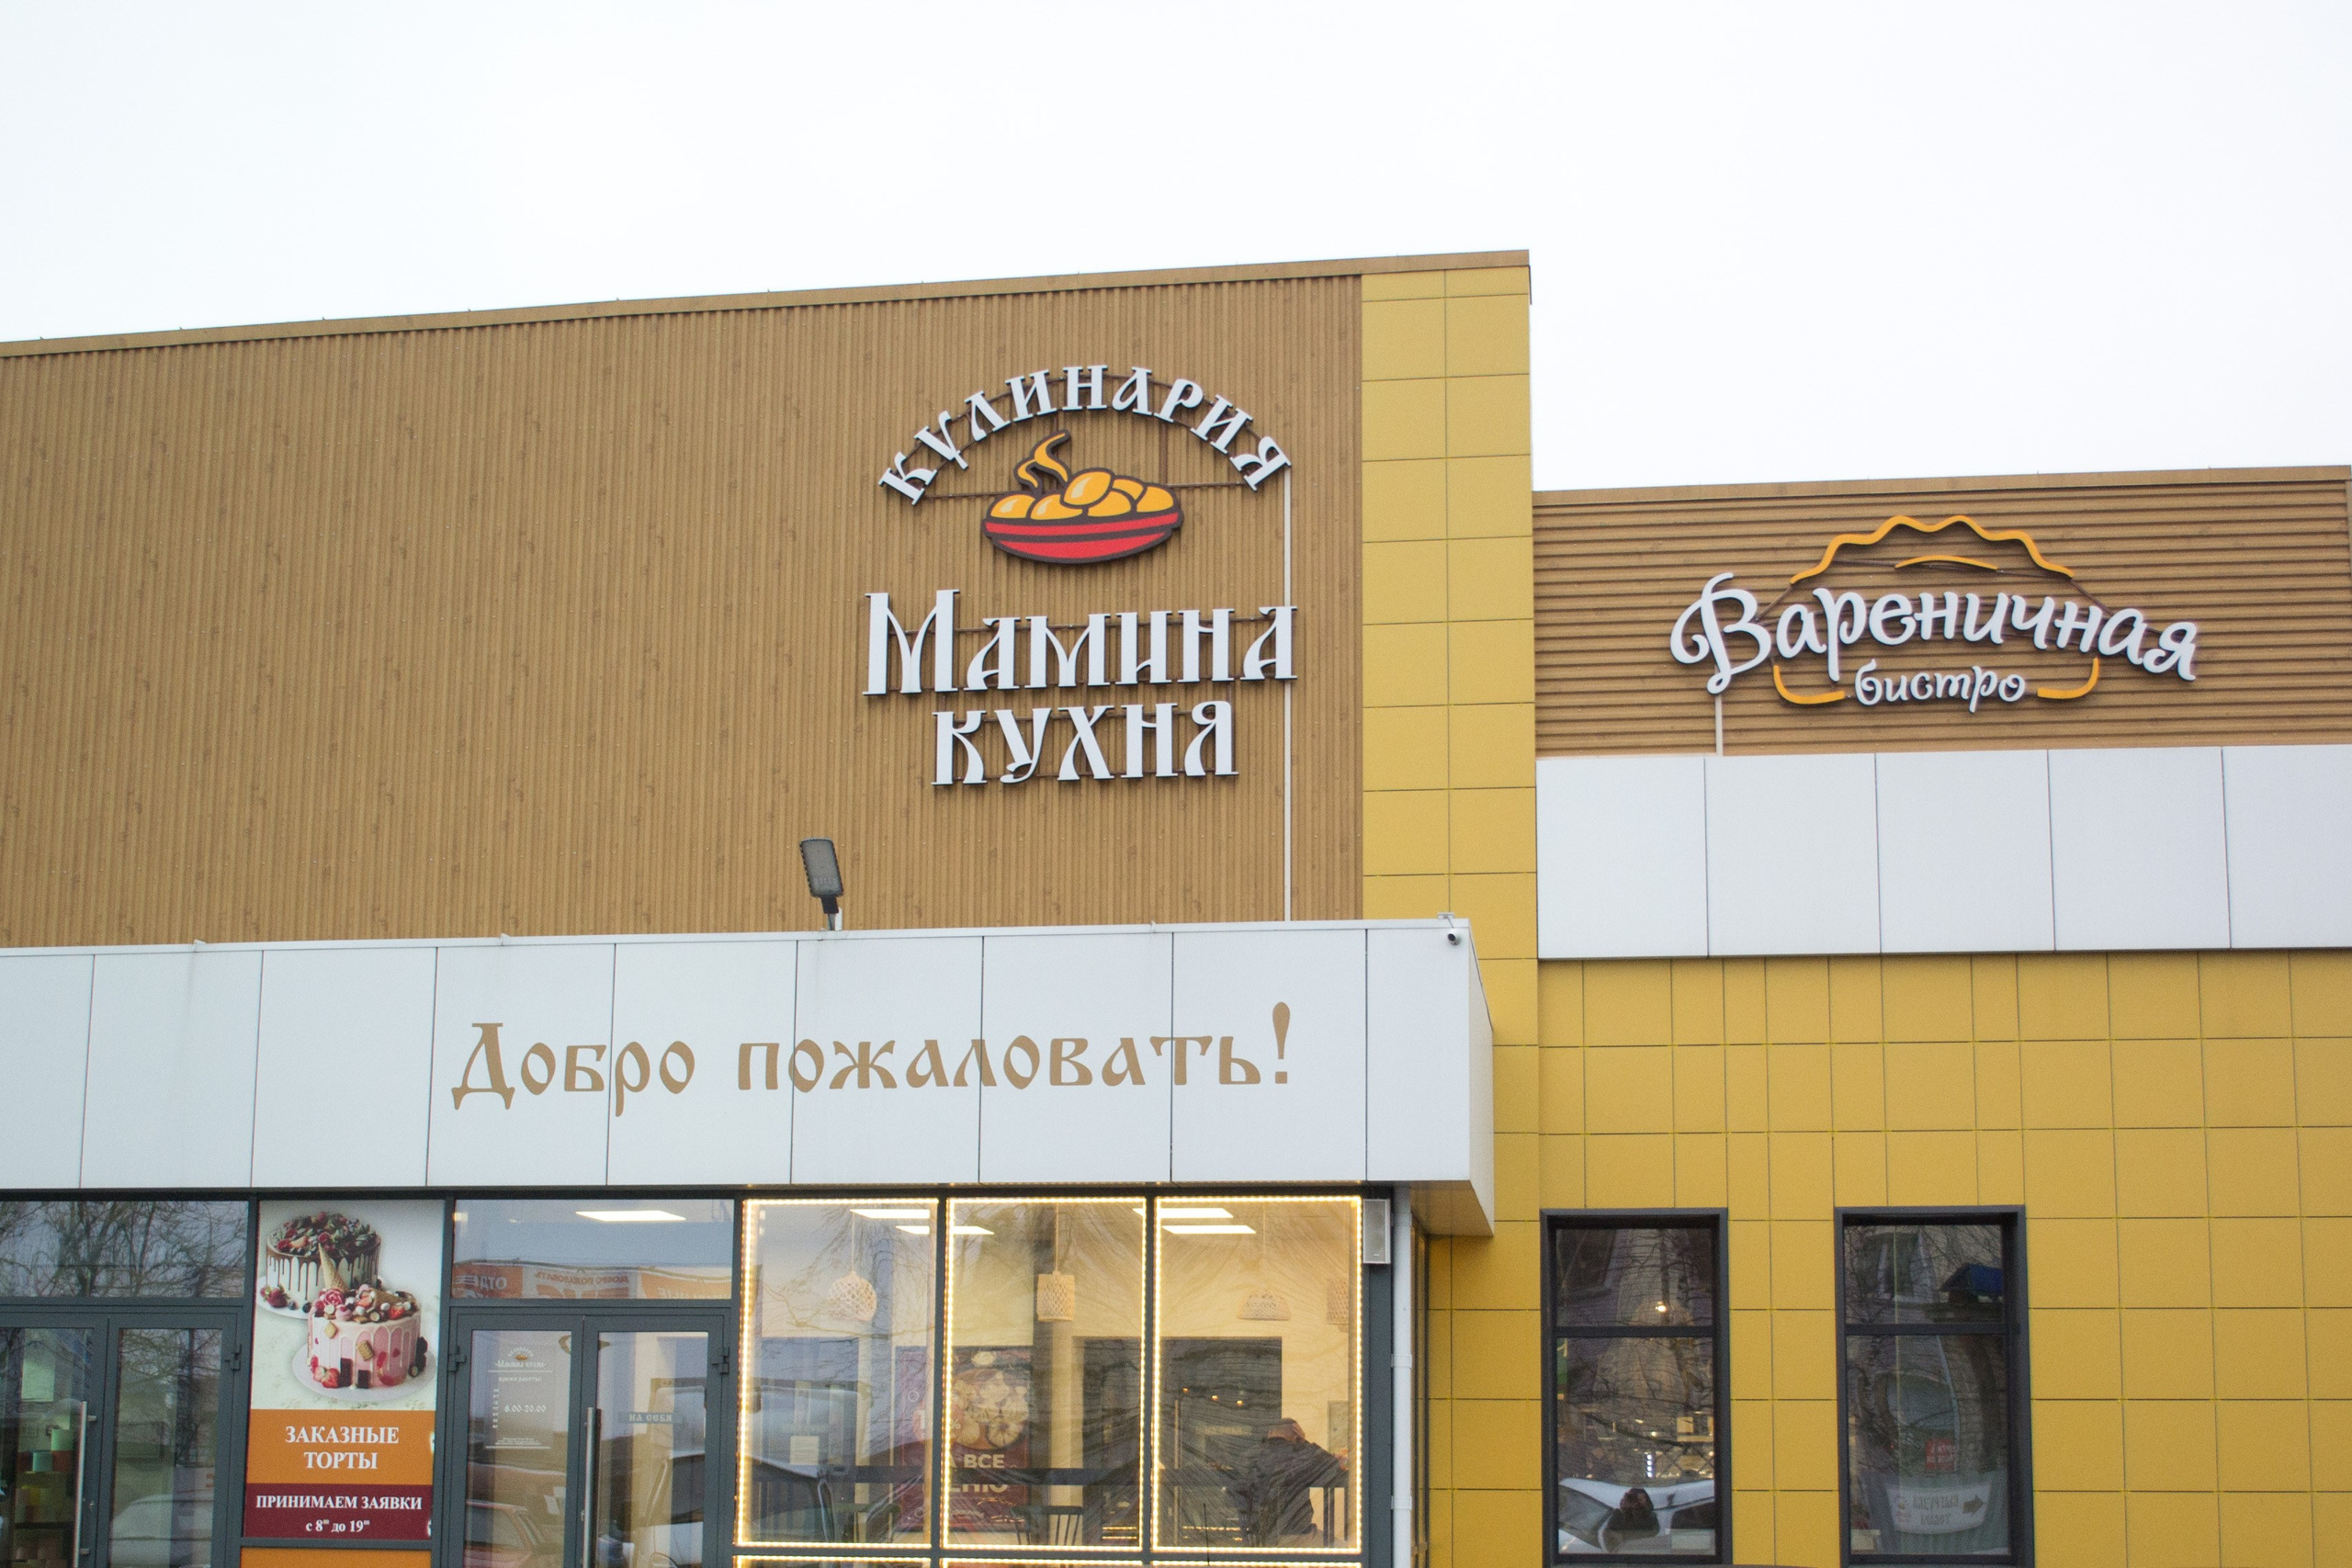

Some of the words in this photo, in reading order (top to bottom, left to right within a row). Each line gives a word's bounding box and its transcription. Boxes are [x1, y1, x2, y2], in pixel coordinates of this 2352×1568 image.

[1670, 572, 2198, 694] Вареничная
[1854, 659, 2027, 714] бистро
[451, 1022, 695, 1117] Добро
[737, 1000, 1291, 1093] пожаловать!
[285, 1426, 400, 1444] ЗАКАЗНЫЕ
[303, 1451, 379, 1470] ТОРТЫ
[255, 1495, 358, 1509] ПРИНИМАЕМ
[360, 1496, 423, 1510] ЗАЯВКИ
[305, 1522, 313, 1532] с
[331, 1523, 346, 1532] до
